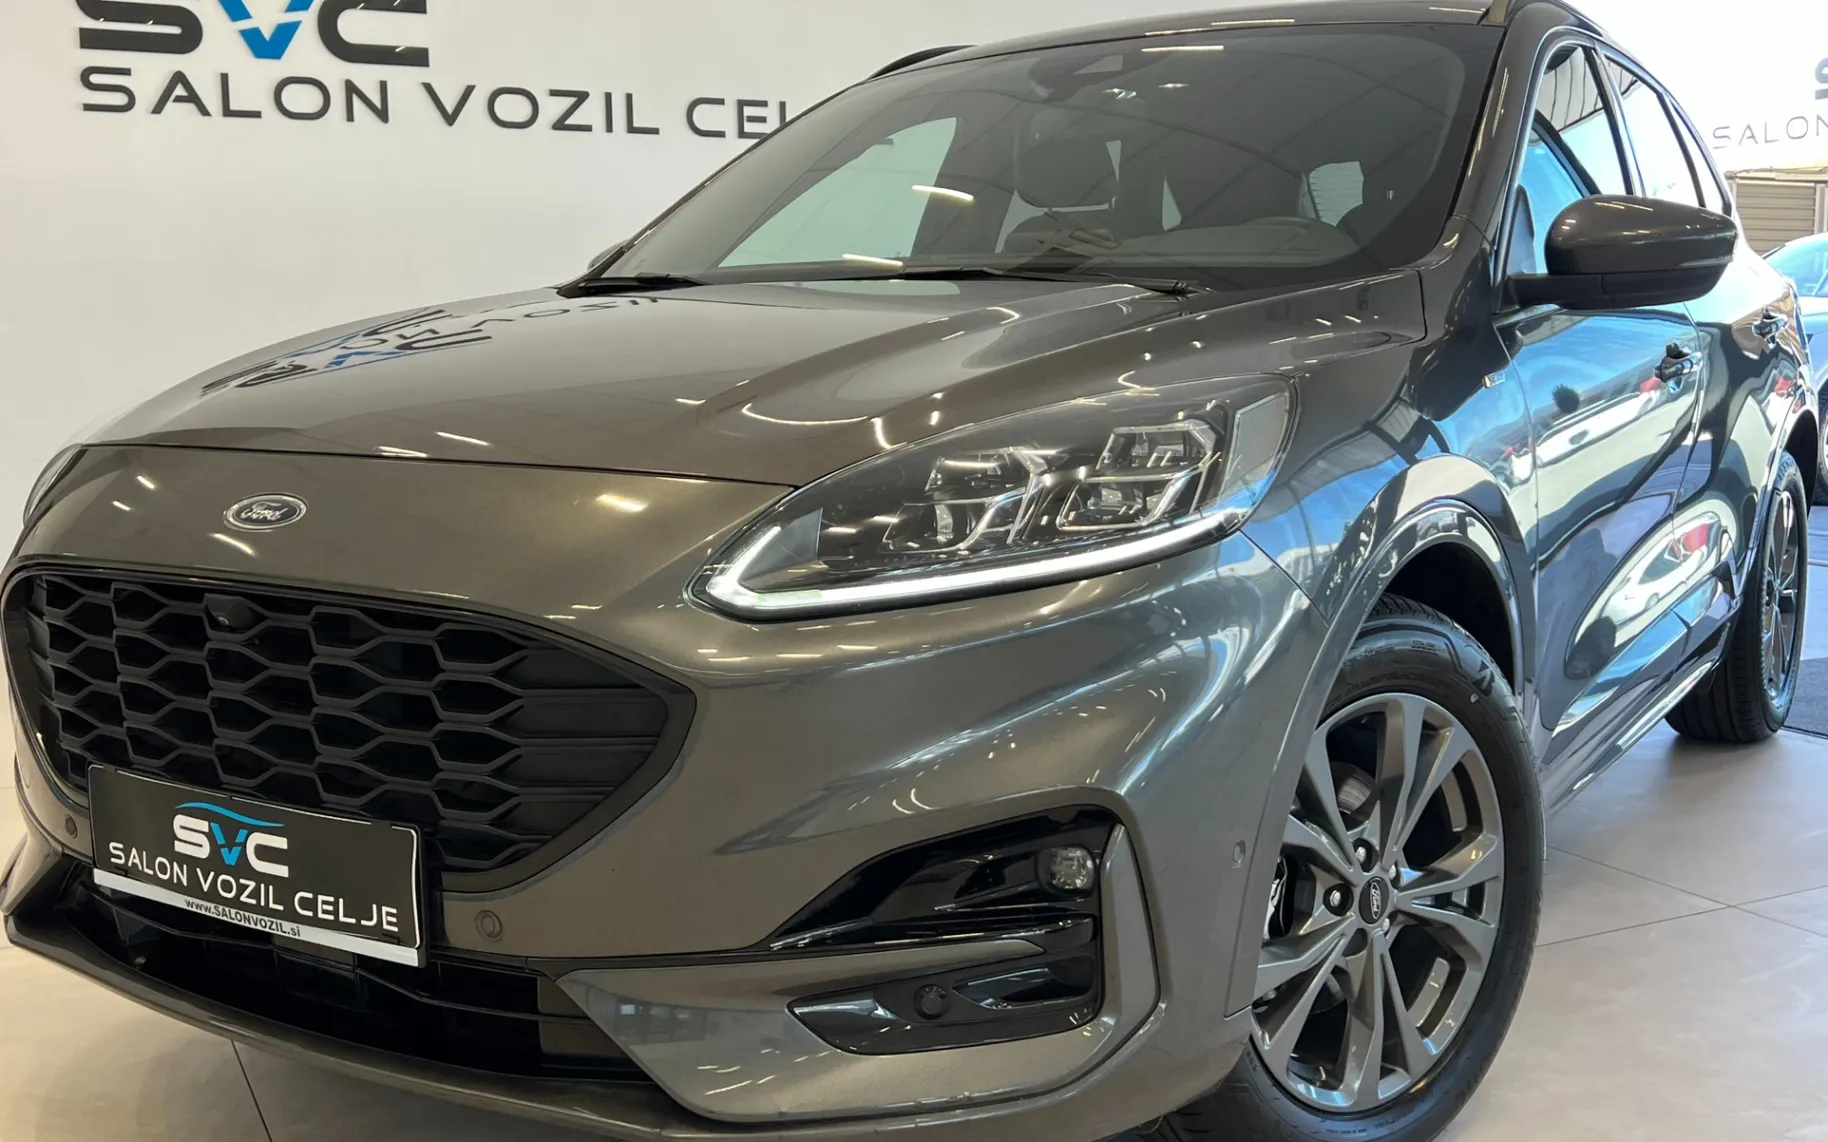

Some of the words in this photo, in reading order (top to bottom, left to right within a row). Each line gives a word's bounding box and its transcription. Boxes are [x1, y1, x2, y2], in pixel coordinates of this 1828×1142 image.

[79, 65, 389, 124] SALON
[421, 81, 660, 135] VOZIL
[239, 501, 288, 521] Ford
[172, 813, 289, 878] SVC
[108, 841, 188, 887] SALON
[196, 867, 284, 911] VOZIL
[293, 891, 399, 932] CELJE
